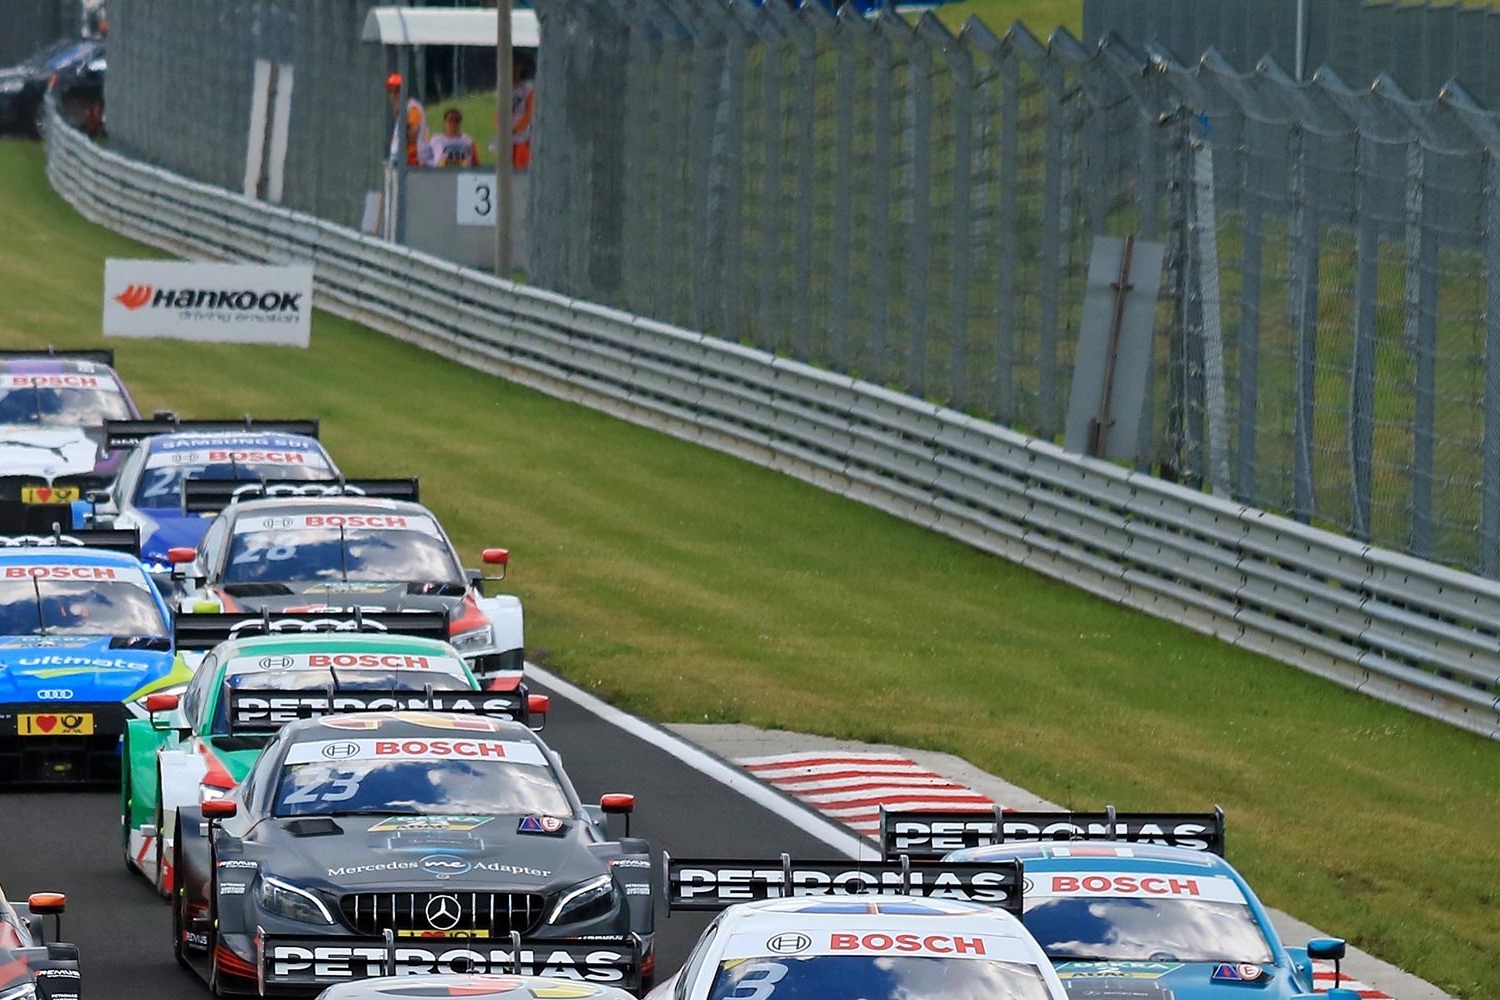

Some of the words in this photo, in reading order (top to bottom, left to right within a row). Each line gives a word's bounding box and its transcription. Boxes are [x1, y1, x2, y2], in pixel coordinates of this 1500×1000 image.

[474, 185, 491, 216] 3
[12, 377, 98, 388] BOSCH
[161, 439, 269, 450] SAMSUNG
[209, 451, 304, 464] BOSCH
[305, 516, 407, 529] BOSCH
[232, 532, 302, 564] 28
[5, 567, 117, 580] BOSCH
[19, 656, 149, 672] ultimate
[309, 655, 430, 669] BOSCH
[238, 698, 514, 722] PETRONAS
[375, 741, 507, 758] BOSCH
[283, 766, 367, 805] 23
[895, 822, 1209, 851] PETRONAS
[328, 860, 419, 878] Mercedes
[424, 859, 466, 869] me
[474, 861, 552, 878] Adapter
[679, 869, 1008, 902] PETRONAS
[1051, 875, 1201, 896] BOSCH
[830, 933, 988, 956] BOSCH
[273, 946, 624, 982] PETRONAS
